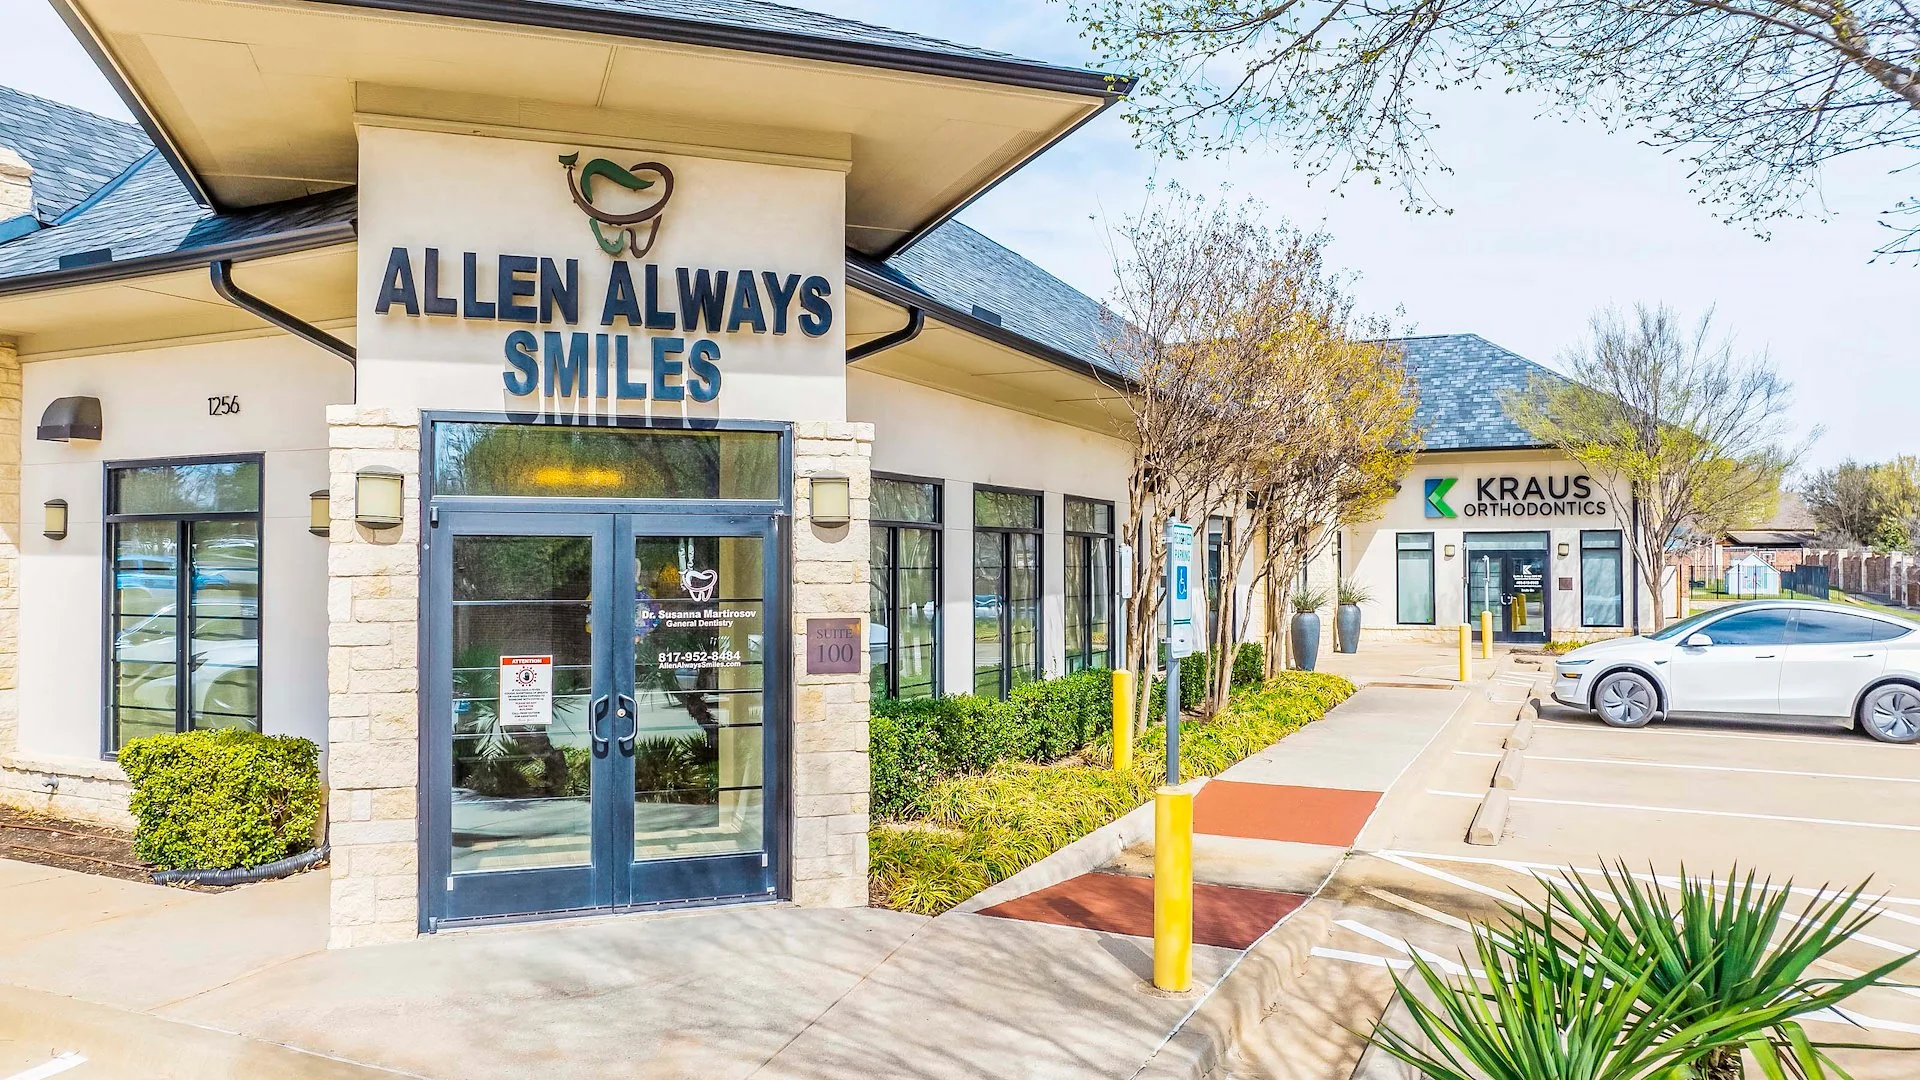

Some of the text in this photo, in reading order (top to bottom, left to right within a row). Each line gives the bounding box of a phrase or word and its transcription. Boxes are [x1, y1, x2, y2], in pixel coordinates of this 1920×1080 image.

[375, 247, 833, 338] ALLEN ALWAYS
[502, 330, 722, 403] SMILES
[208, 395, 240, 415] 1256
[1477, 475, 1592, 501] KRAUS
[1463, 501, 1606, 517] ORTHODONTICS
[641, 609, 757, 619] Dr. Susanna Martirosov
[666, 619, 734, 628] General Dentistry
[816, 628, 853, 639] SUITE
[658, 651, 741, 663] 817-952-8484
[818, 643, 854, 663] 100
[658, 661, 741, 669] AllenAlwaysSmiles.com
